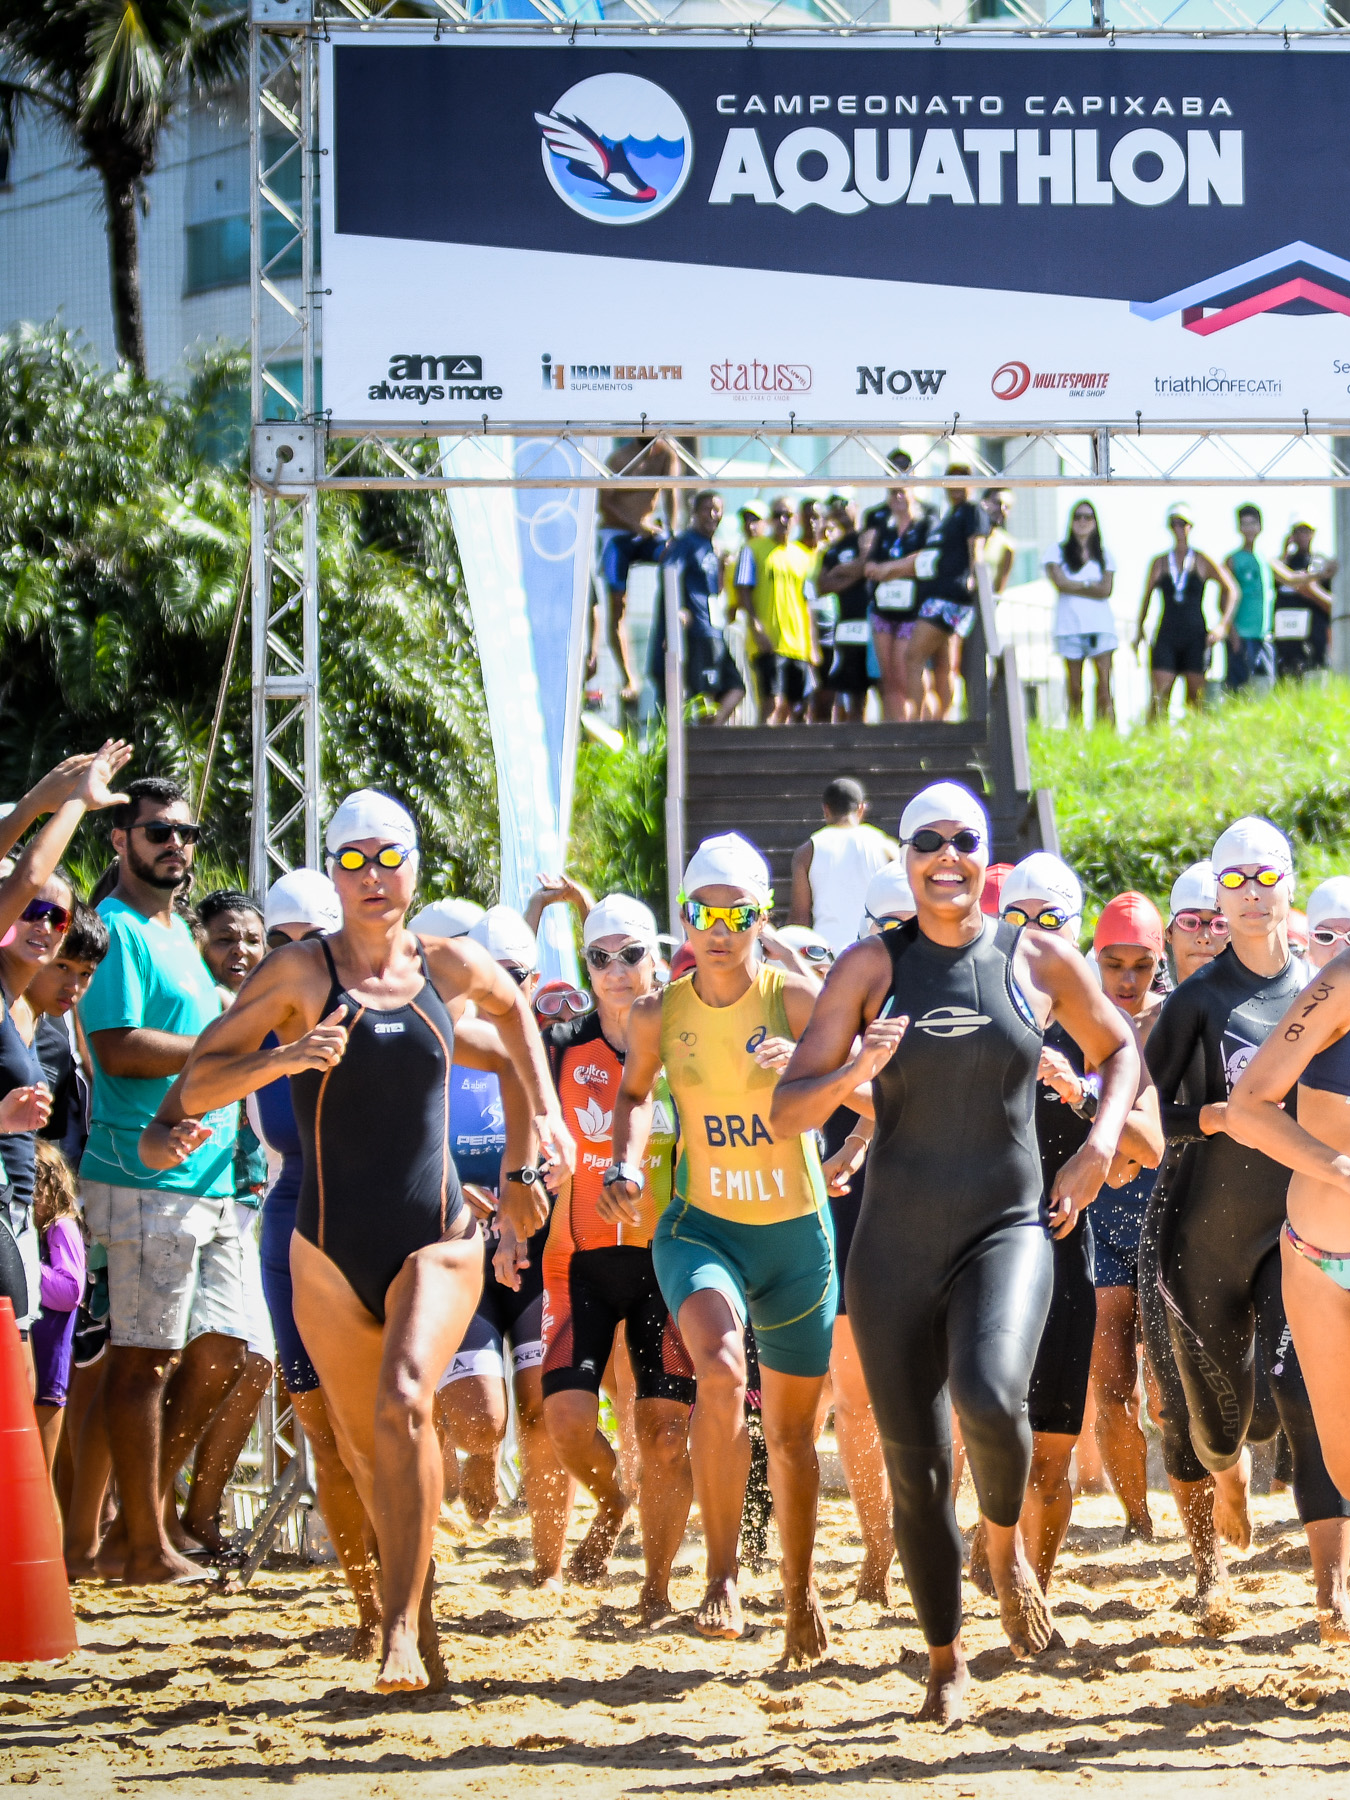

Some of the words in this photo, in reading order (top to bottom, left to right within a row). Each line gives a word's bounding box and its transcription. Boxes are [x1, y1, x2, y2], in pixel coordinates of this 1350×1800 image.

[716, 94, 1003, 115] CAMPEONATO
[1024, 95, 1233, 116] CAPIXABA
[708, 126, 1243, 215] AQUATHLON
[570, 365, 611, 380] IRON
[613, 365, 682, 380] HEALTH
[710, 358, 793, 391] status
[1031, 372, 1110, 389] MULTESPORTE
[368, 380, 445, 406] always
[449, 384, 503, 401] more
[570, 383, 633, 391] SUPLEMENTOS
[1069, 389, 1085, 398] BIKE
[1086, 389, 1106, 398] SHOP
[704, 1113, 773, 1148] BRA
[710, 1167, 785, 1201] EMILY
